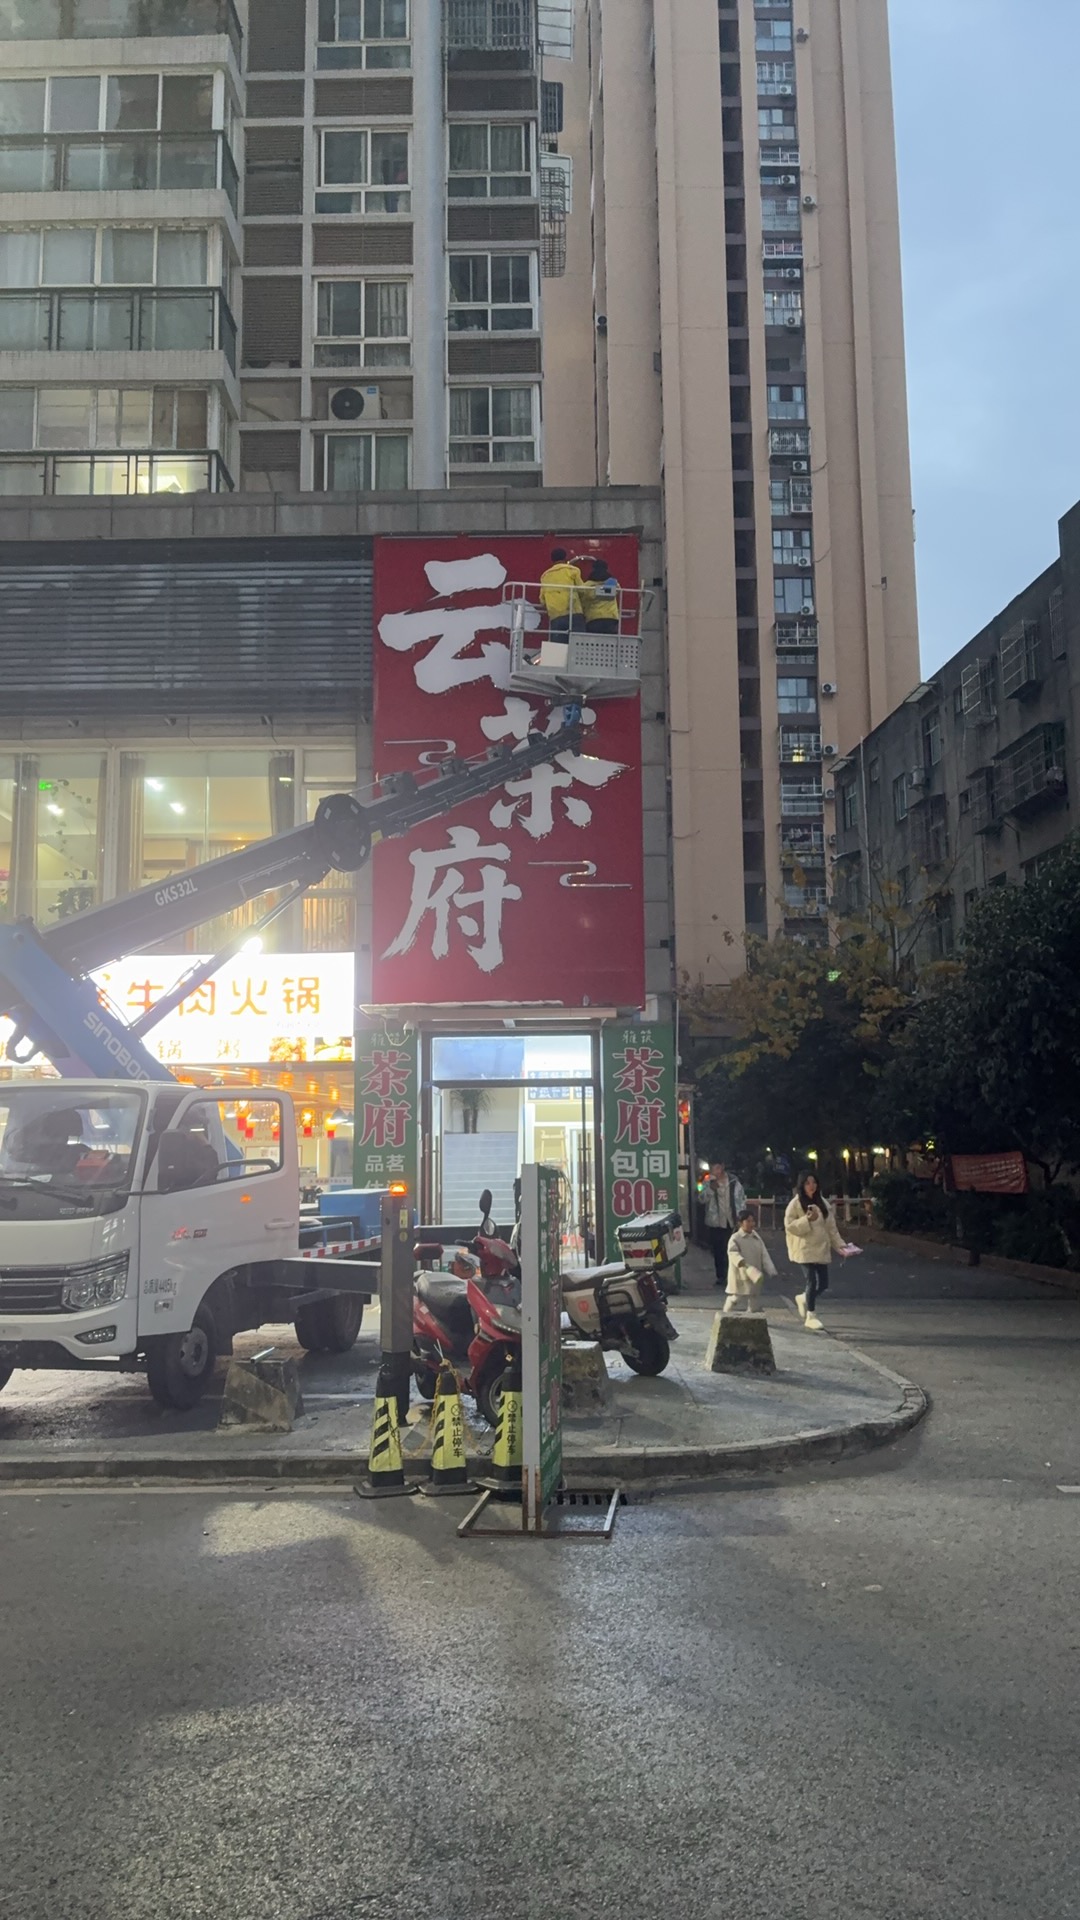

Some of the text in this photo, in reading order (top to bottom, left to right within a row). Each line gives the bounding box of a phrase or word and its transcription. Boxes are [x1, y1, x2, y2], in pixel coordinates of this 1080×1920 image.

[377, 553, 635, 974] 云茶府
[154, 878, 199, 908] GKS32L
[359, 1050, 412, 1148] 茶府
[611, 1046, 667, 1146] 茶府
[365, 1154, 406, 1173] 品茗
[610, 1148, 671, 1179] 包间
[611, 1178, 656, 1218] 80
[451, 1416, 464, 1458] 禁止停车
[506, 1413, 517, 1456] 禁止停车
